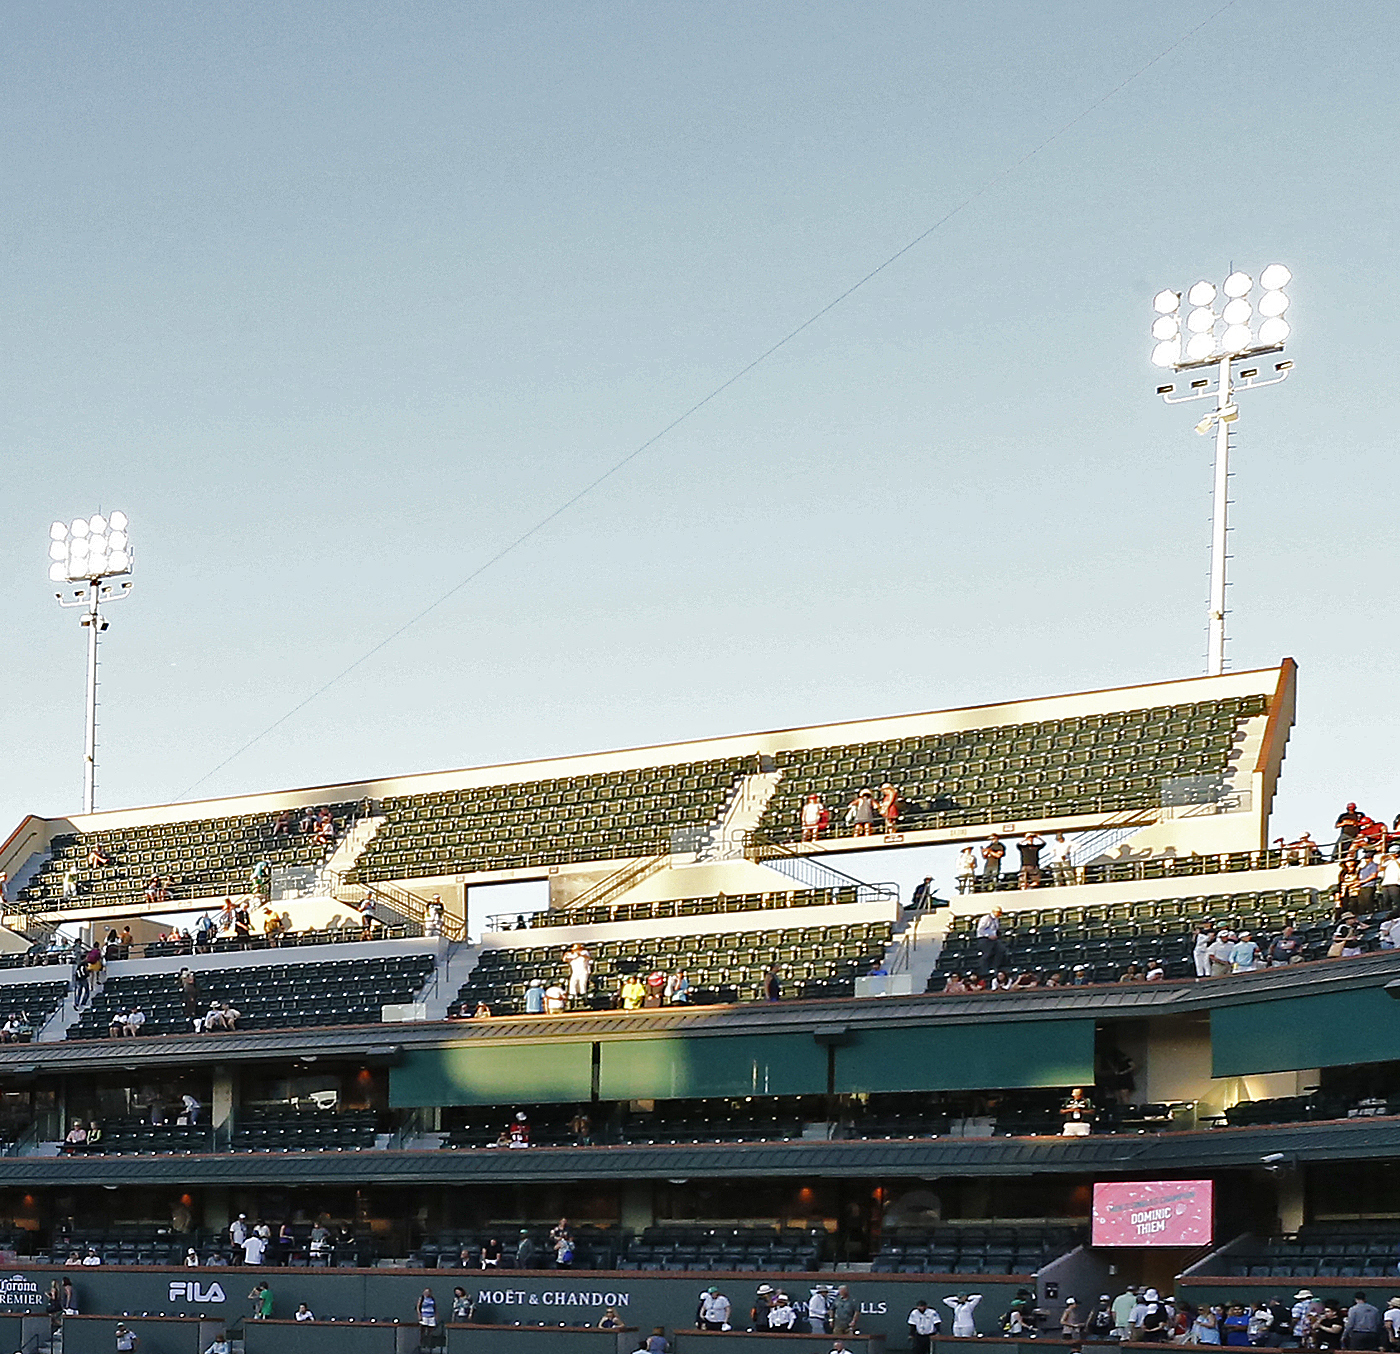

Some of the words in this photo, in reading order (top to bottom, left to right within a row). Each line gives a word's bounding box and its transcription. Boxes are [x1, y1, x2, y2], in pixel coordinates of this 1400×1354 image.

[1130, 1207, 1173, 1225] DOMINIC
[1136, 1219, 1166, 1235] THIEM
[169, 1281, 226, 1303] FILA
[529, 1293, 539, 1305] &
[542, 1291, 630, 1307] CHANDON
